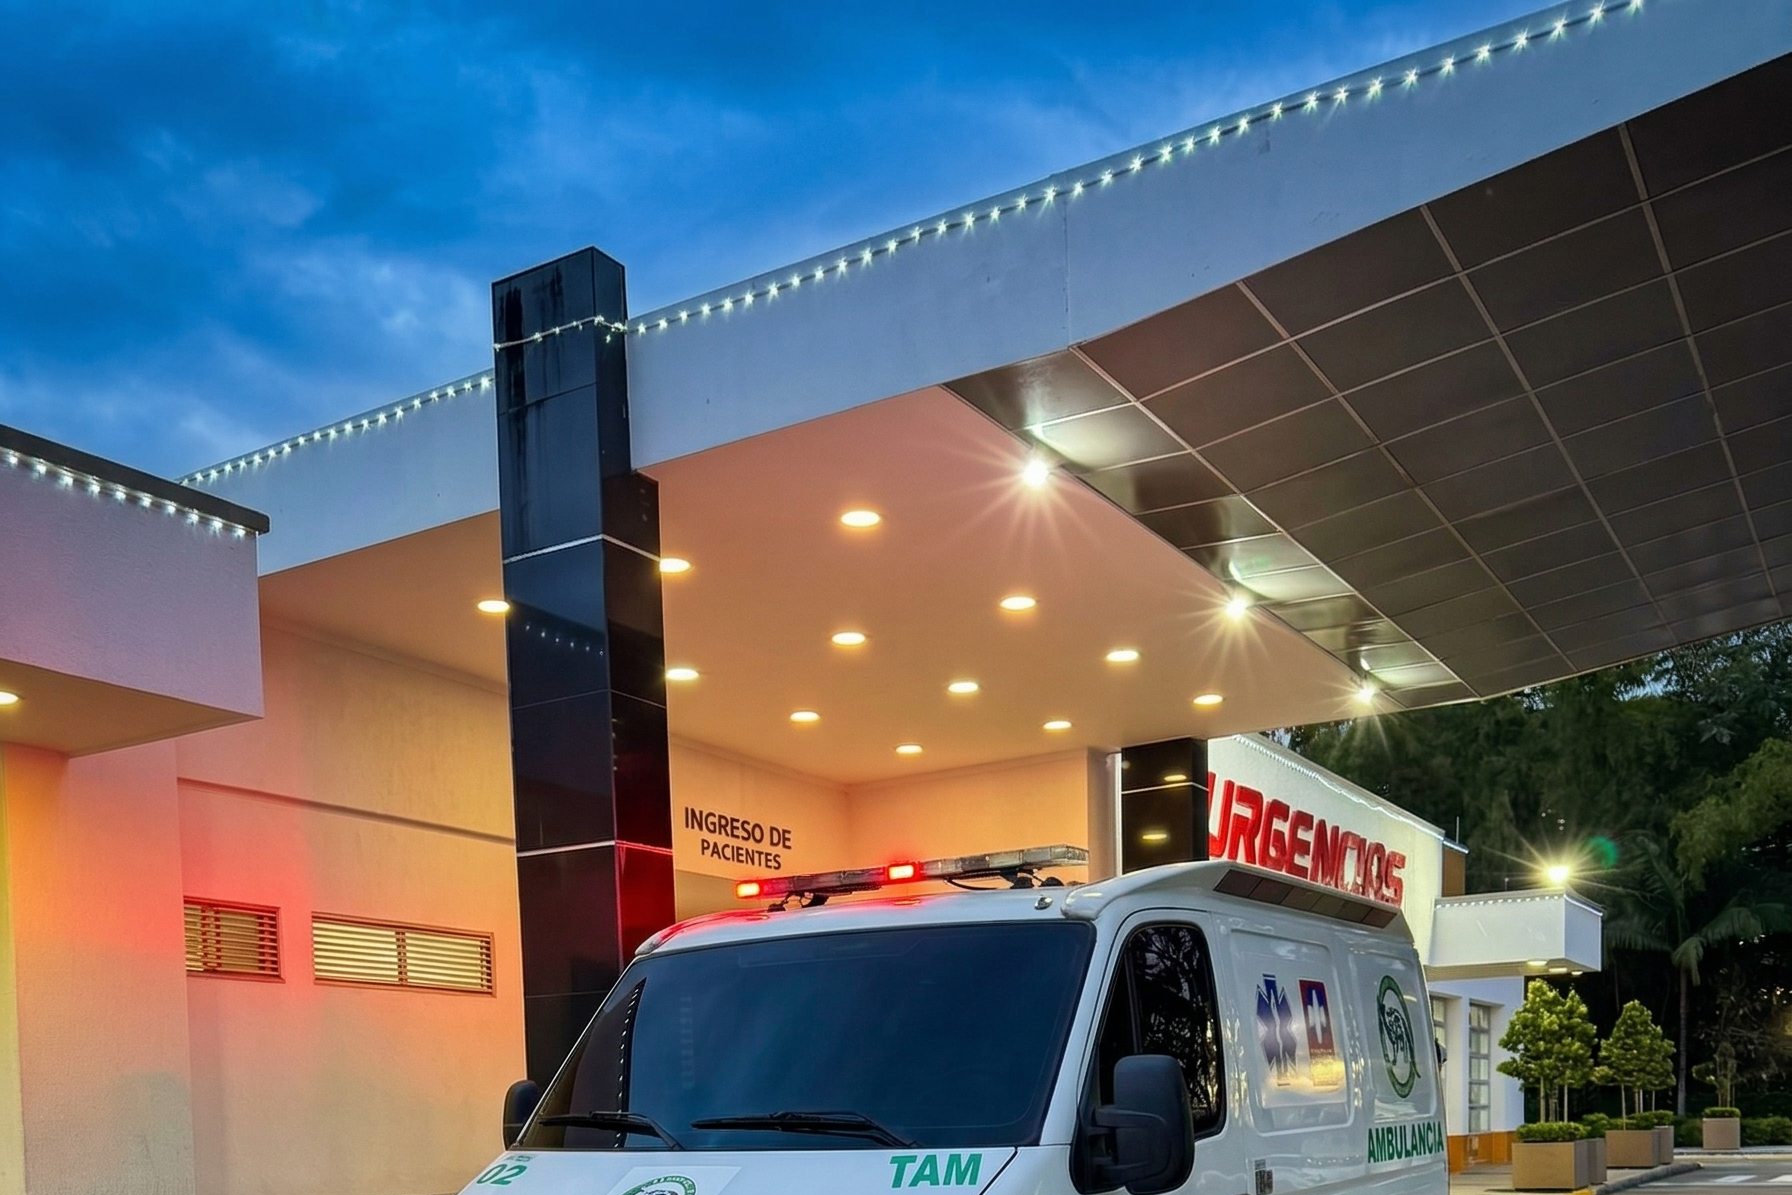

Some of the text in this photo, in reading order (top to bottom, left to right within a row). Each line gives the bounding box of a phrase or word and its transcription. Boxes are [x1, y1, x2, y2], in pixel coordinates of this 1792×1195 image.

[684, 806, 792, 850] INGRESO DE
[701, 839, 782, 870] PACIENTES
[1368, 1120, 1444, 1163] AMBULANCIA
[476, 1163, 528, 1186] 02
[889, 1153, 982, 1188] TAM
